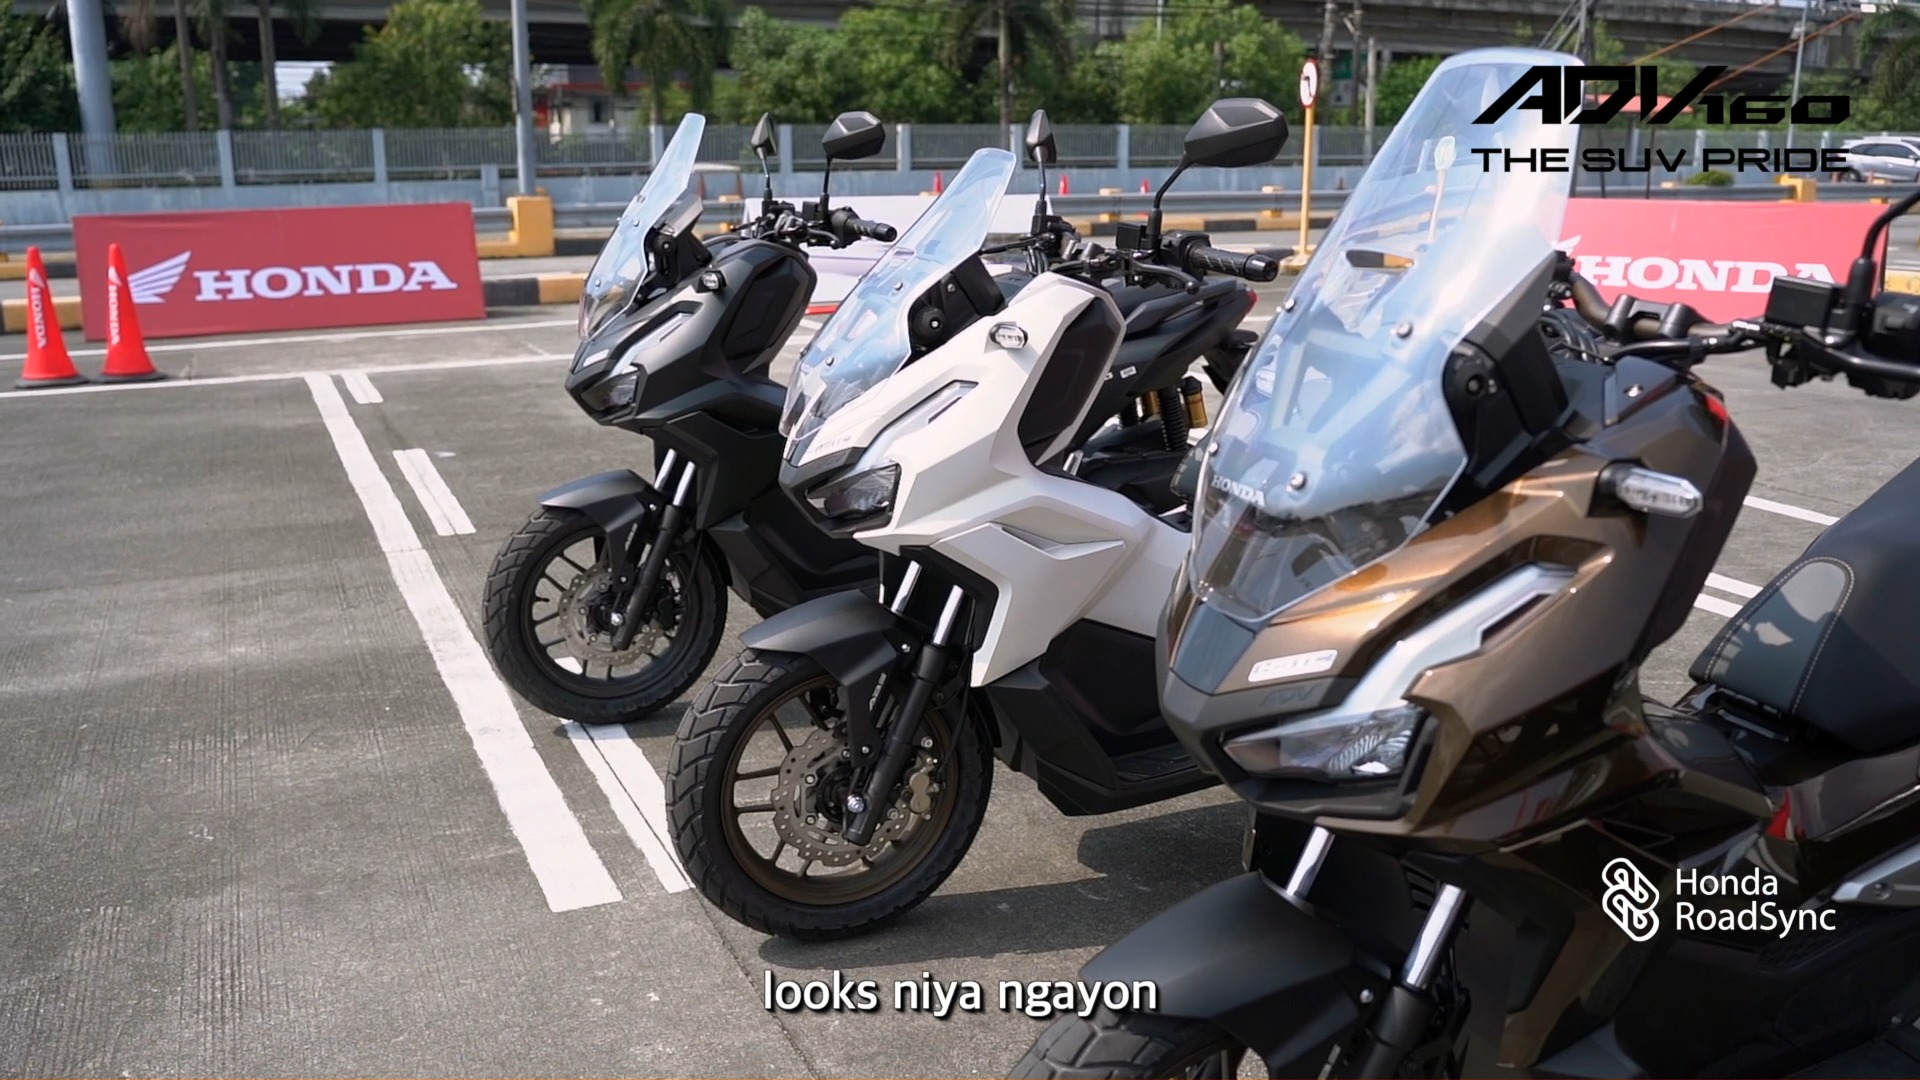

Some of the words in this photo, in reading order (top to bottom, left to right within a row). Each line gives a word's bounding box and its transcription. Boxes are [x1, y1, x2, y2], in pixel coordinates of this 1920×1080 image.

[193, 260, 458, 301] HONDA
[30, 286, 47, 349] HONDA
[1211, 474, 1265, 507] HONDA
